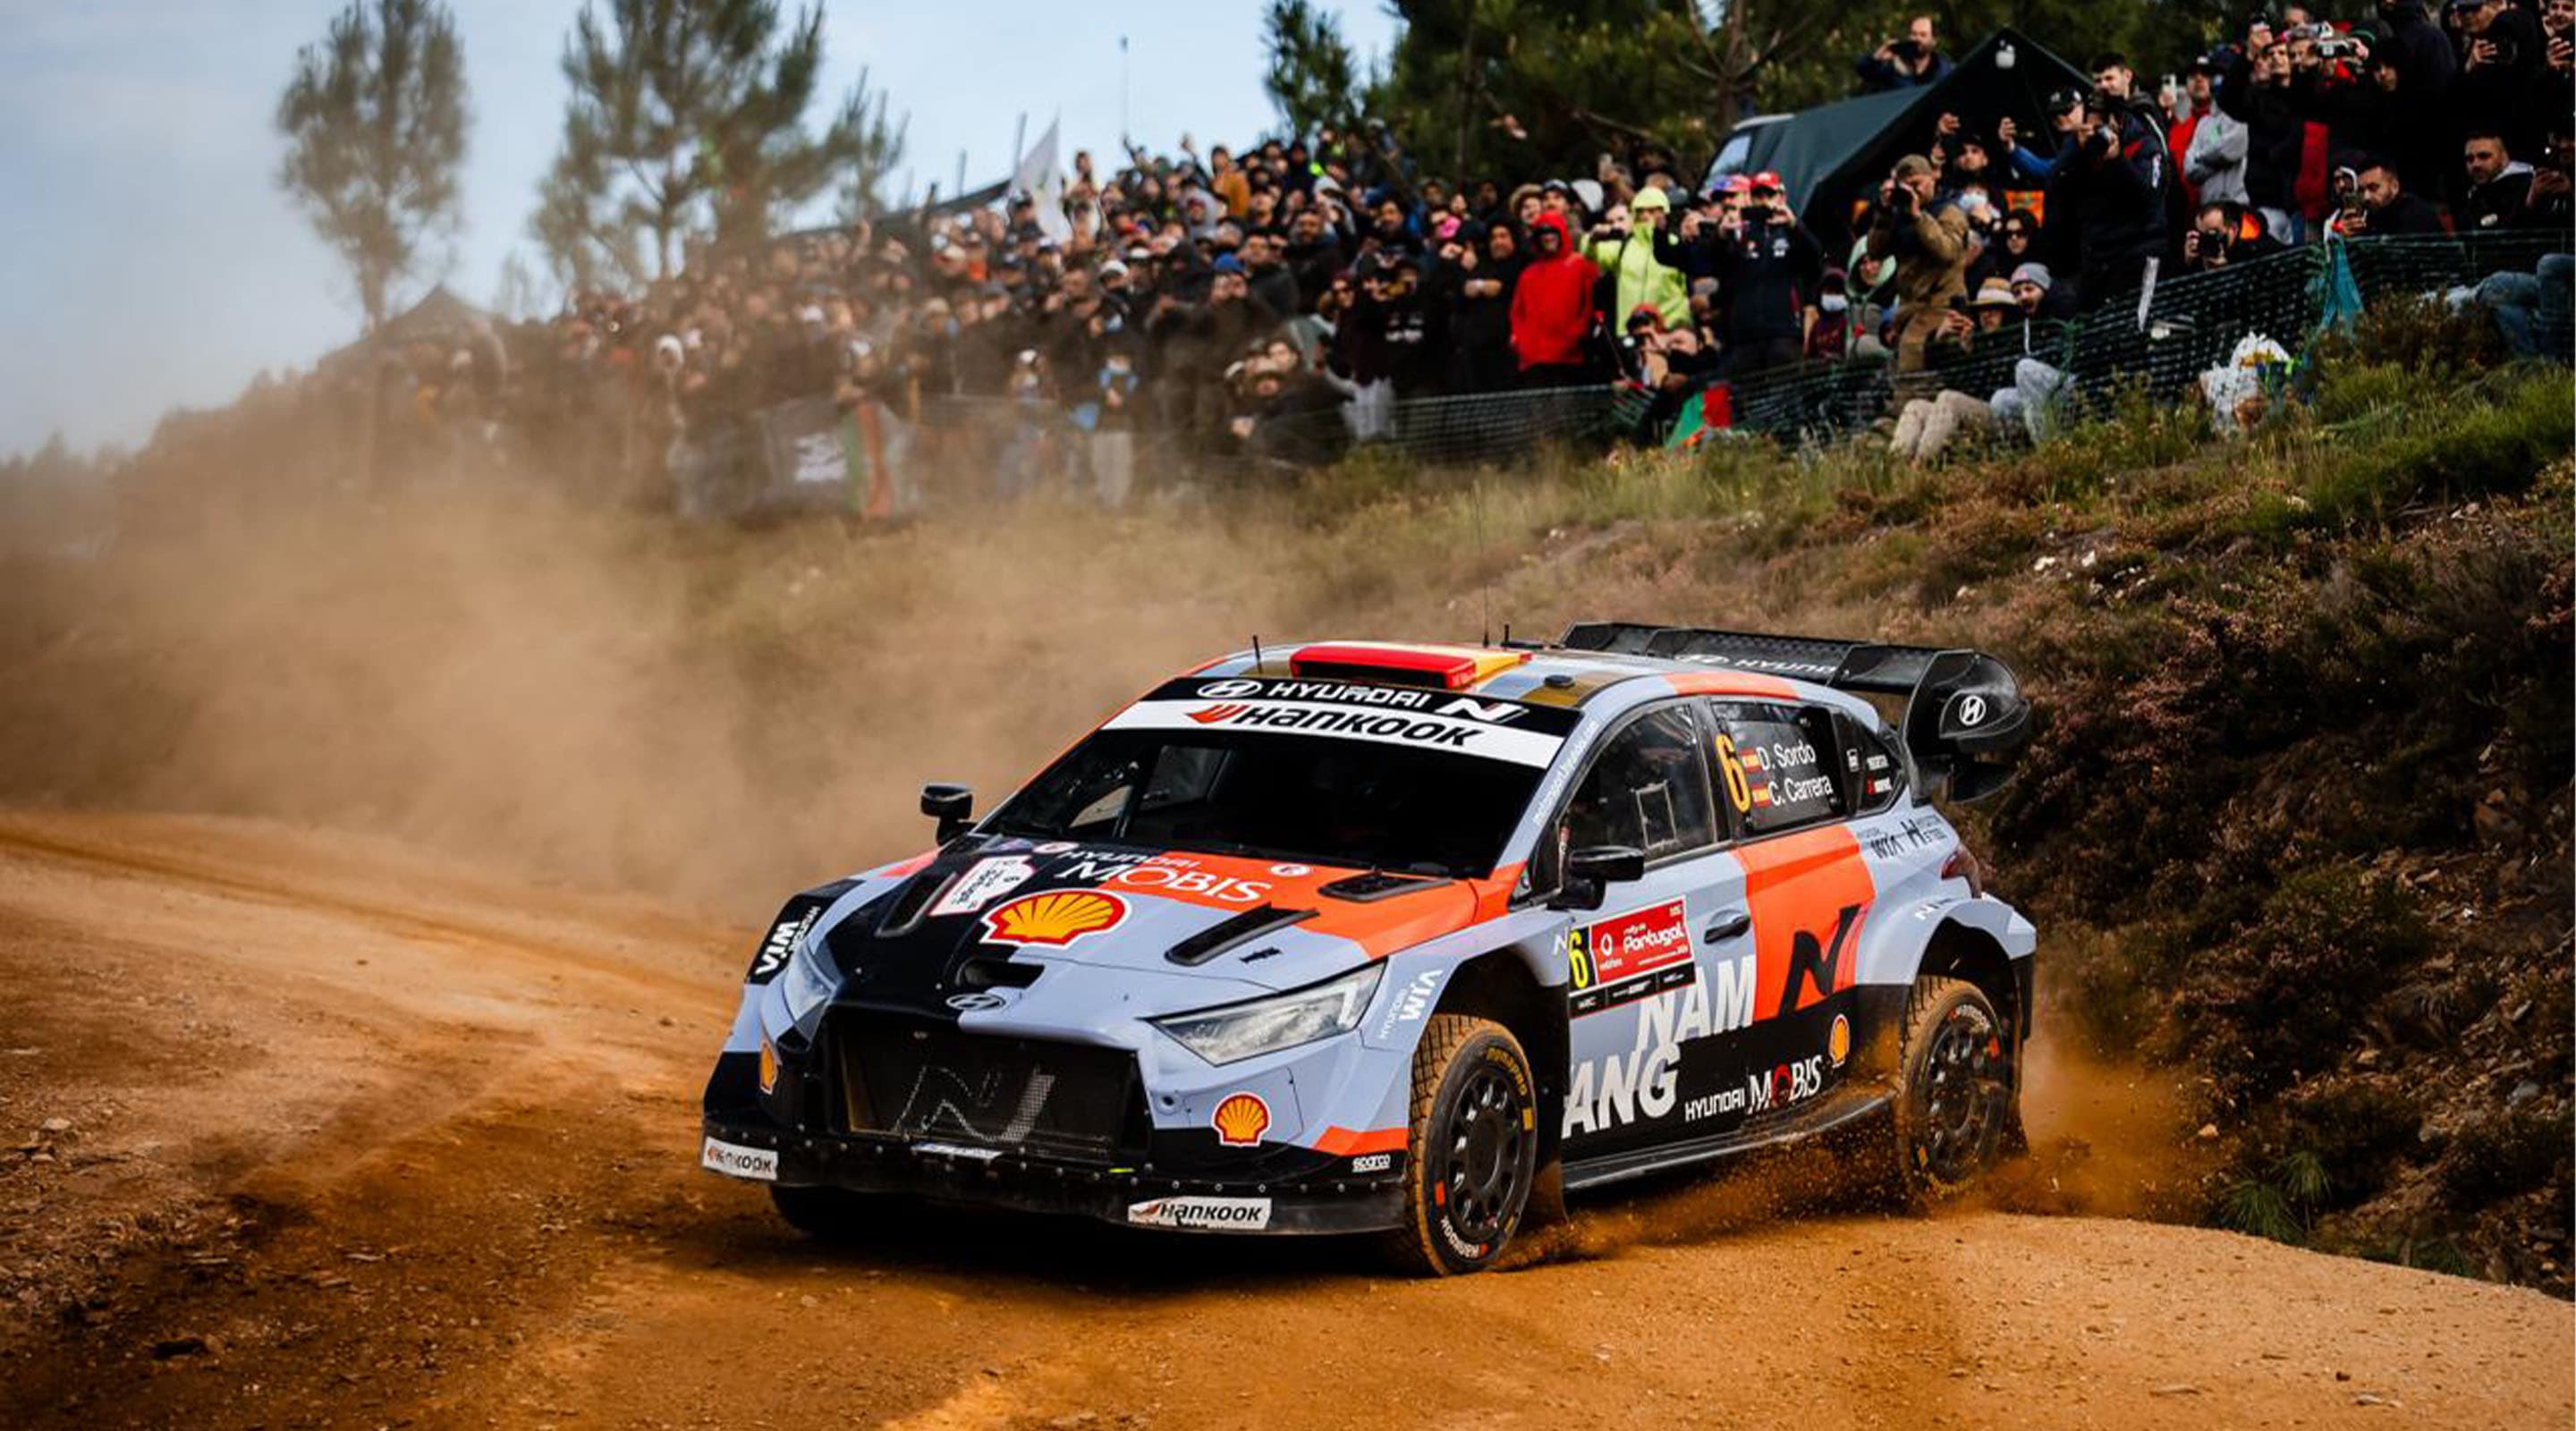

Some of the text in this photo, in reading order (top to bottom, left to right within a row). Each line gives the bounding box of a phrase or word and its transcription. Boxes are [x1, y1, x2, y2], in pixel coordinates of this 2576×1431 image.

[1735, 659, 1838, 673] HYUND
[1267, 681, 1432, 708] HYUNDAI
[1716, 734, 1751, 813] 6
[1756, 746, 1776, 771] D.
[1774, 740, 1817, 768] Sordo
[1768, 775, 1834, 806] C. Carrera
[1058, 851, 1201, 868] HYUNDAI
[1054, 861, 1273, 902] MOBIS
[1569, 929, 1589, 988] 6
[1623, 921, 1685, 955] Portugal
[1779, 904, 1862, 1020] N
[1636, 954, 1757, 1051] NAM
[1561, 1042, 1681, 1139] ANG
[1685, 1054, 1823, 1122] HYUNDAI MOBIS
